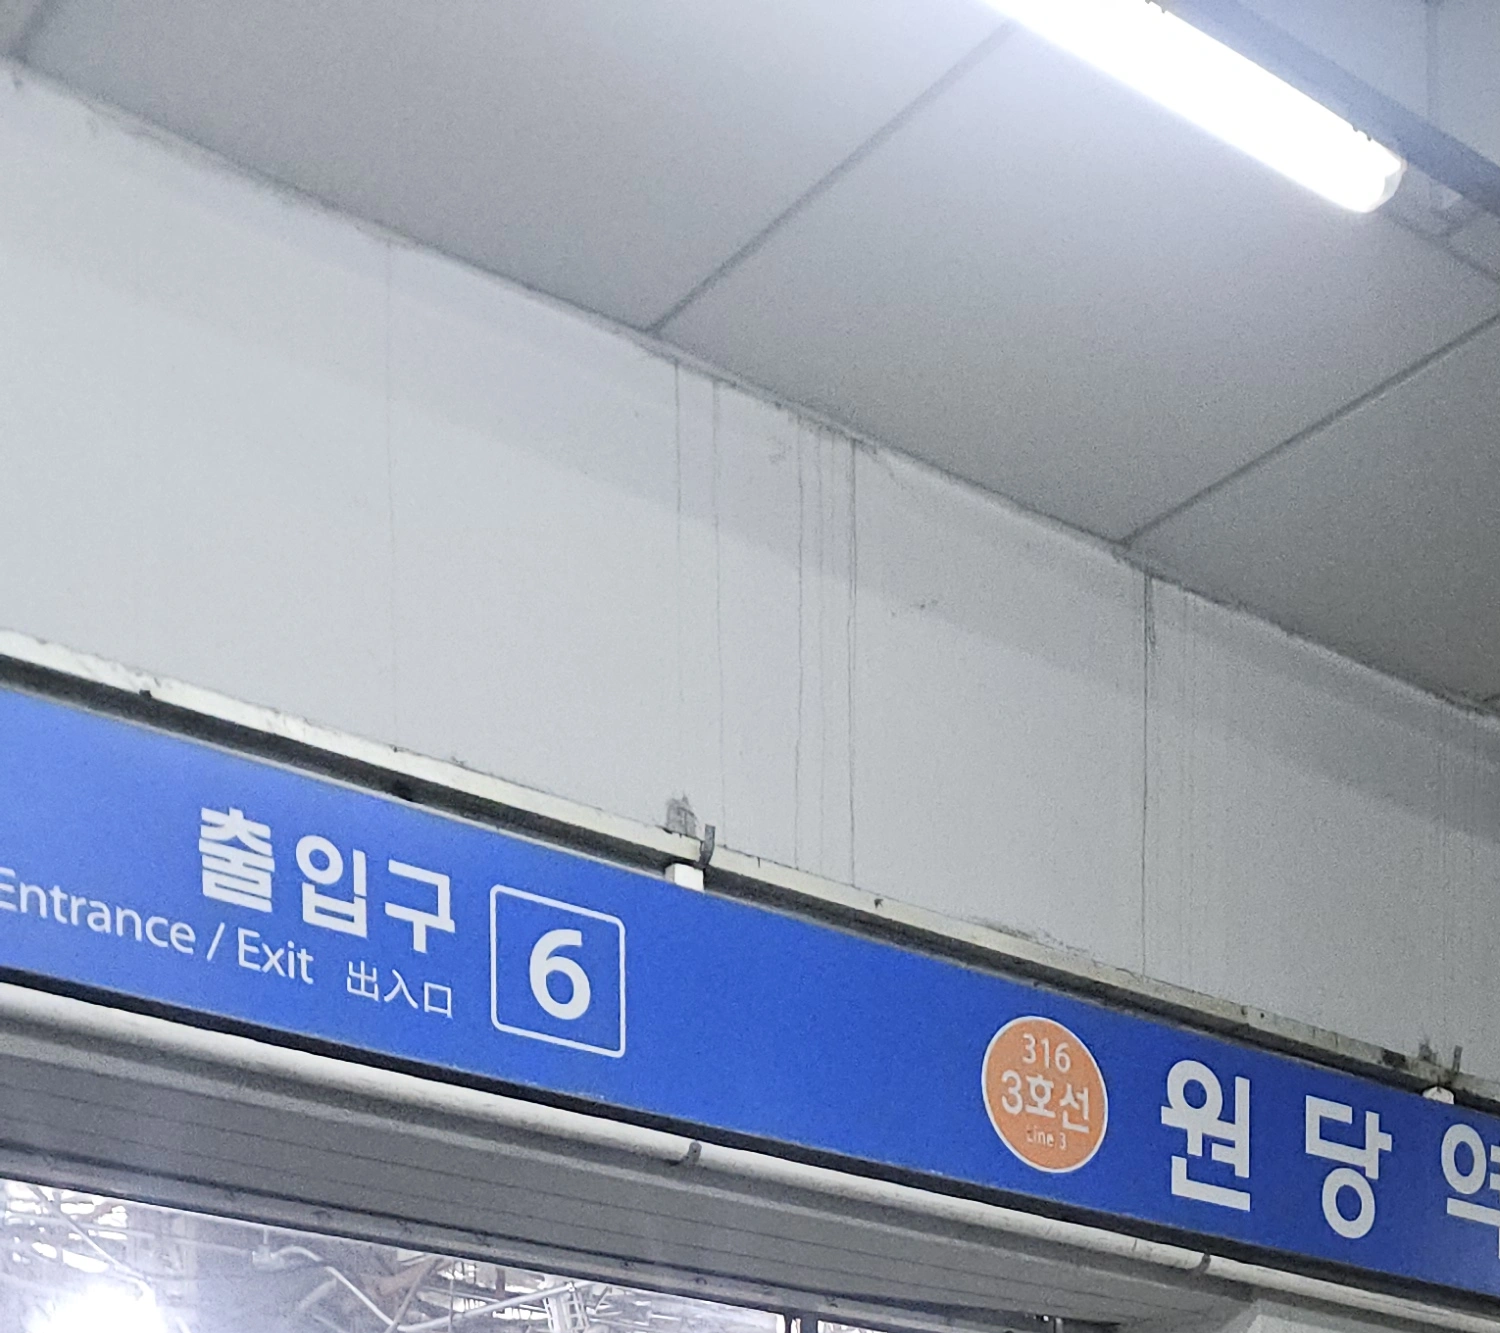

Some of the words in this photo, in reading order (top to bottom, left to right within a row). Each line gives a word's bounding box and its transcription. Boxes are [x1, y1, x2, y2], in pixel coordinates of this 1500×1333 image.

[198, 805, 456, 955] 출입구
[0, 866, 196, 956] Entrance
[237, 930, 314, 986] Exit
[345, 960, 454, 1019] 出入口
[528, 927, 592, 1021] 6
[1021, 1033, 1072, 1073] 316
[1001, 1069, 1090, 1134] 3호선
